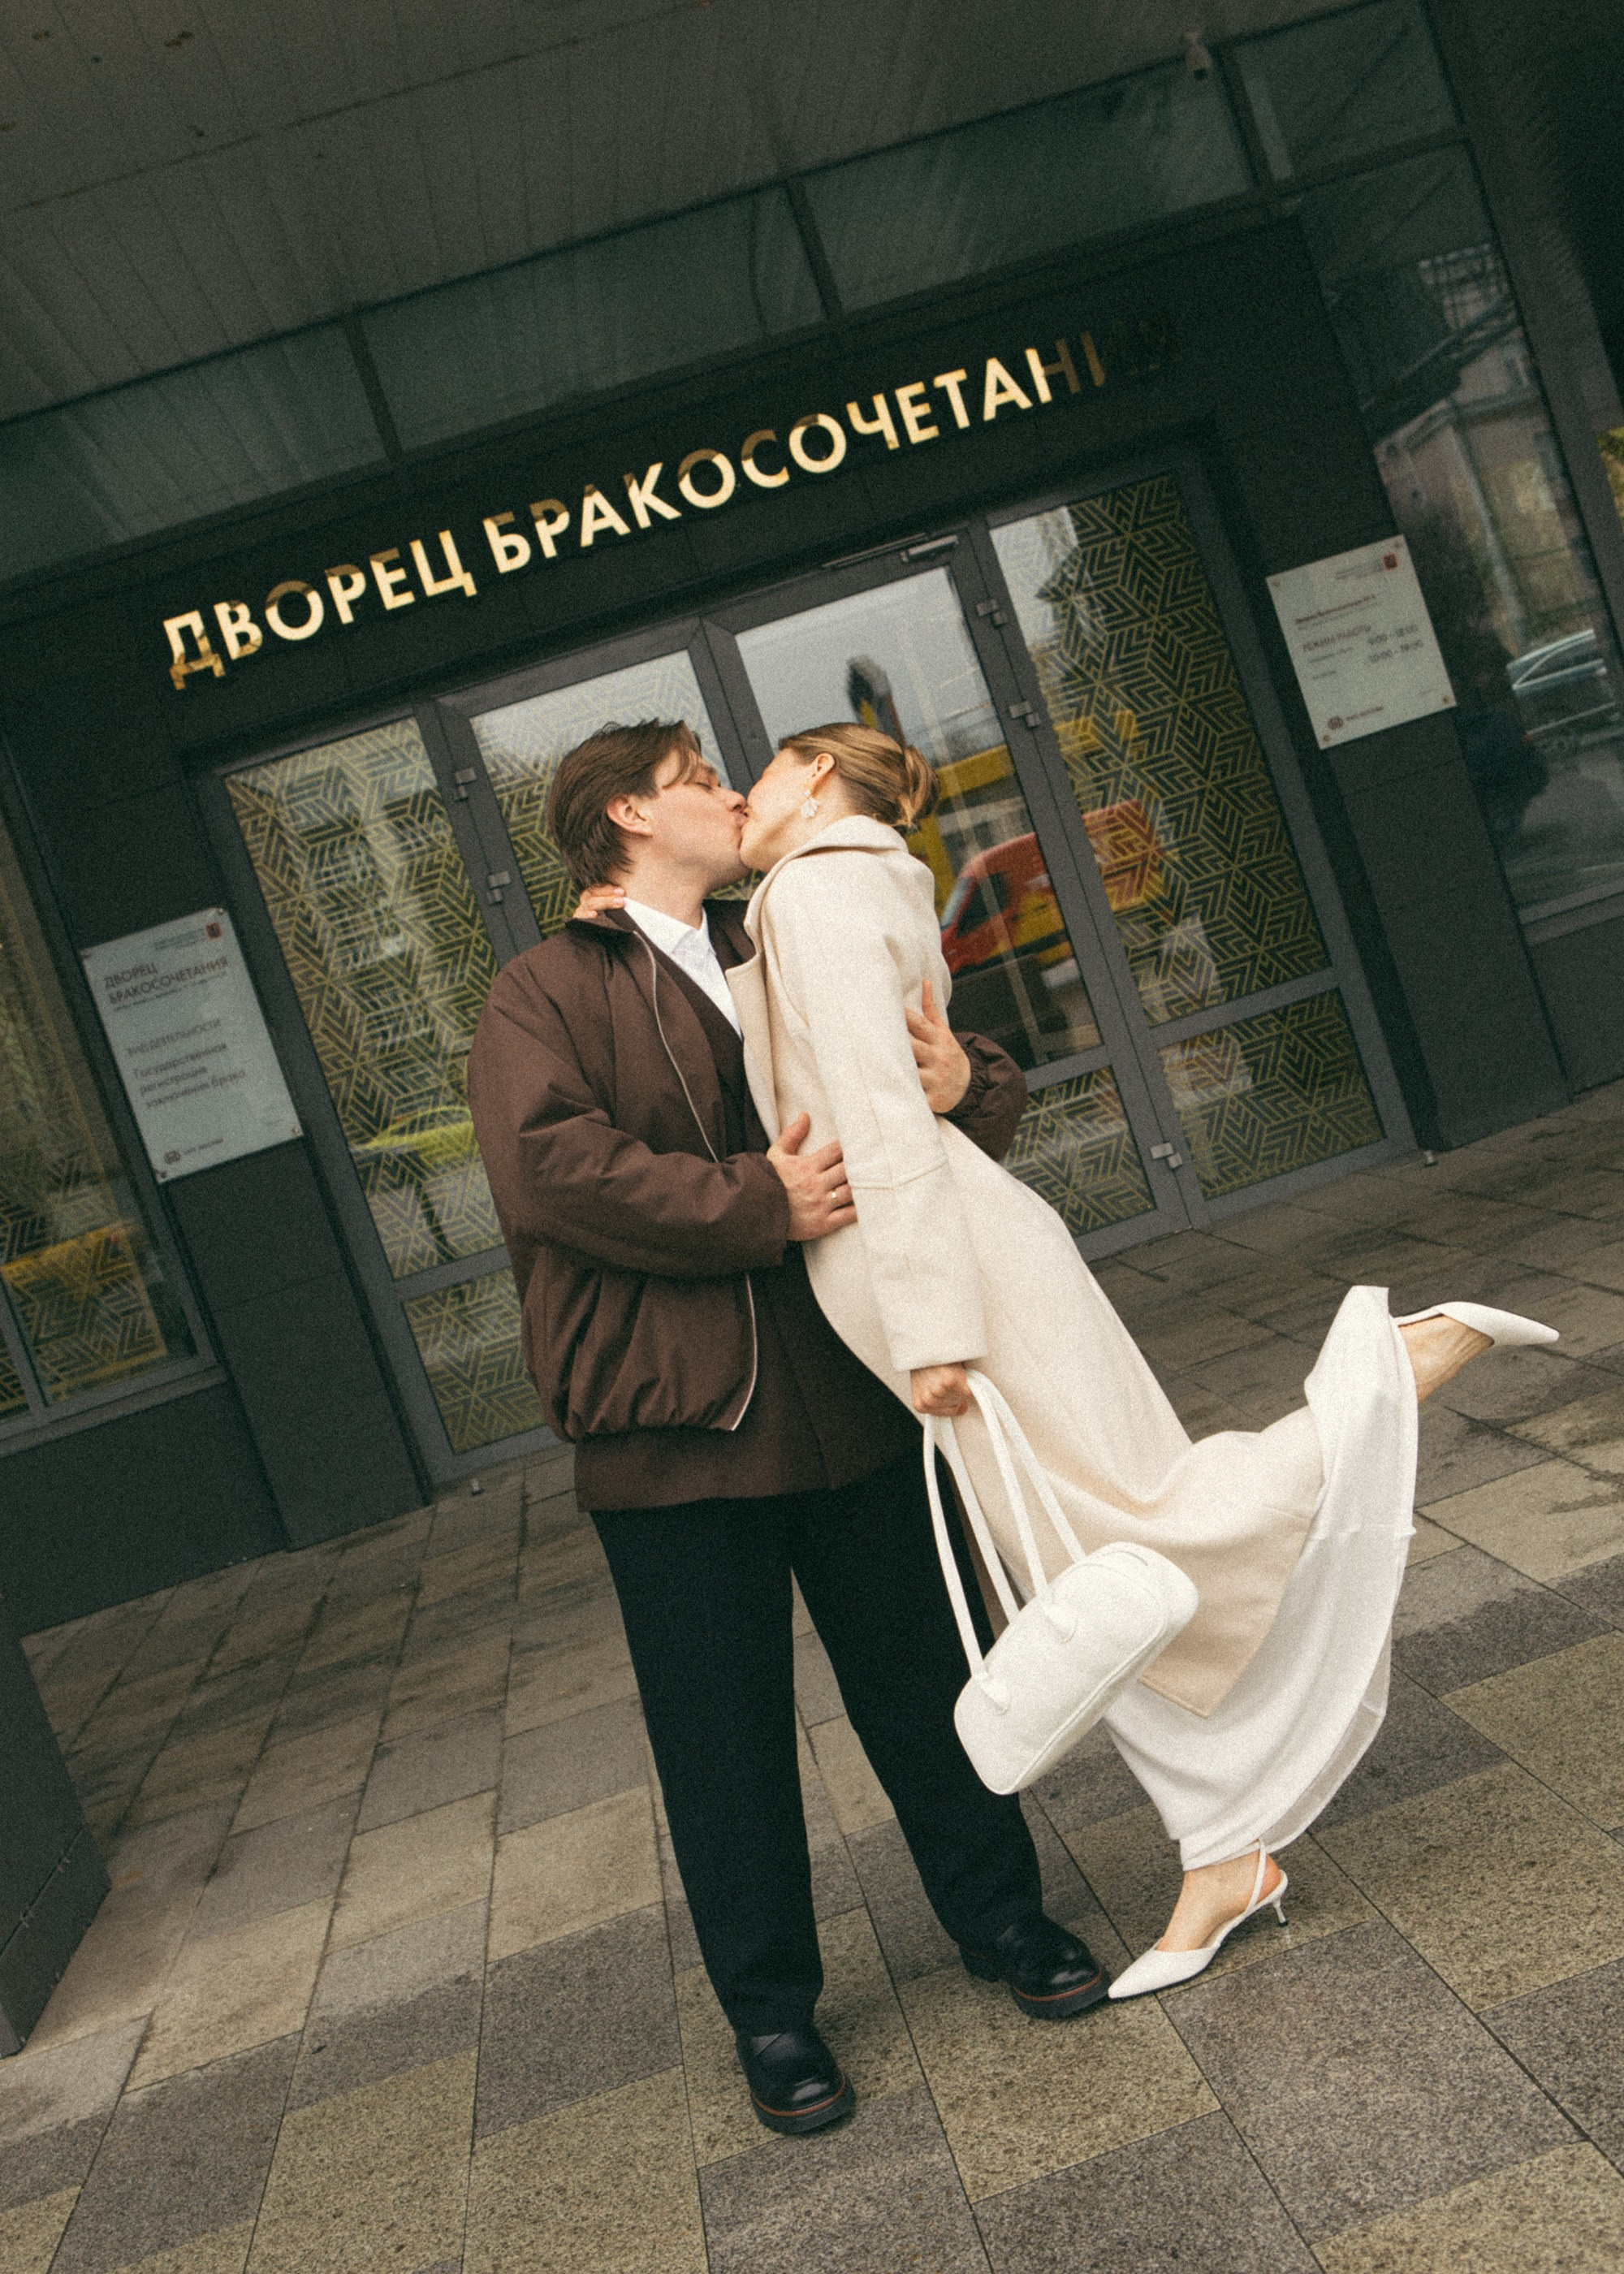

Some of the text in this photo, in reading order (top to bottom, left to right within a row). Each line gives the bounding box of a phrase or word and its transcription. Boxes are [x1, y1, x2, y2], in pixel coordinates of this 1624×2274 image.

[162, 320, 1182, 690] ДВОРЕЦ БРАКОСОЧЕТАН
[102, 962, 158, 989] ДВОРЕЦ
[106, 956, 230, 1005] БРАКОСОЧЕТАНИЯ
